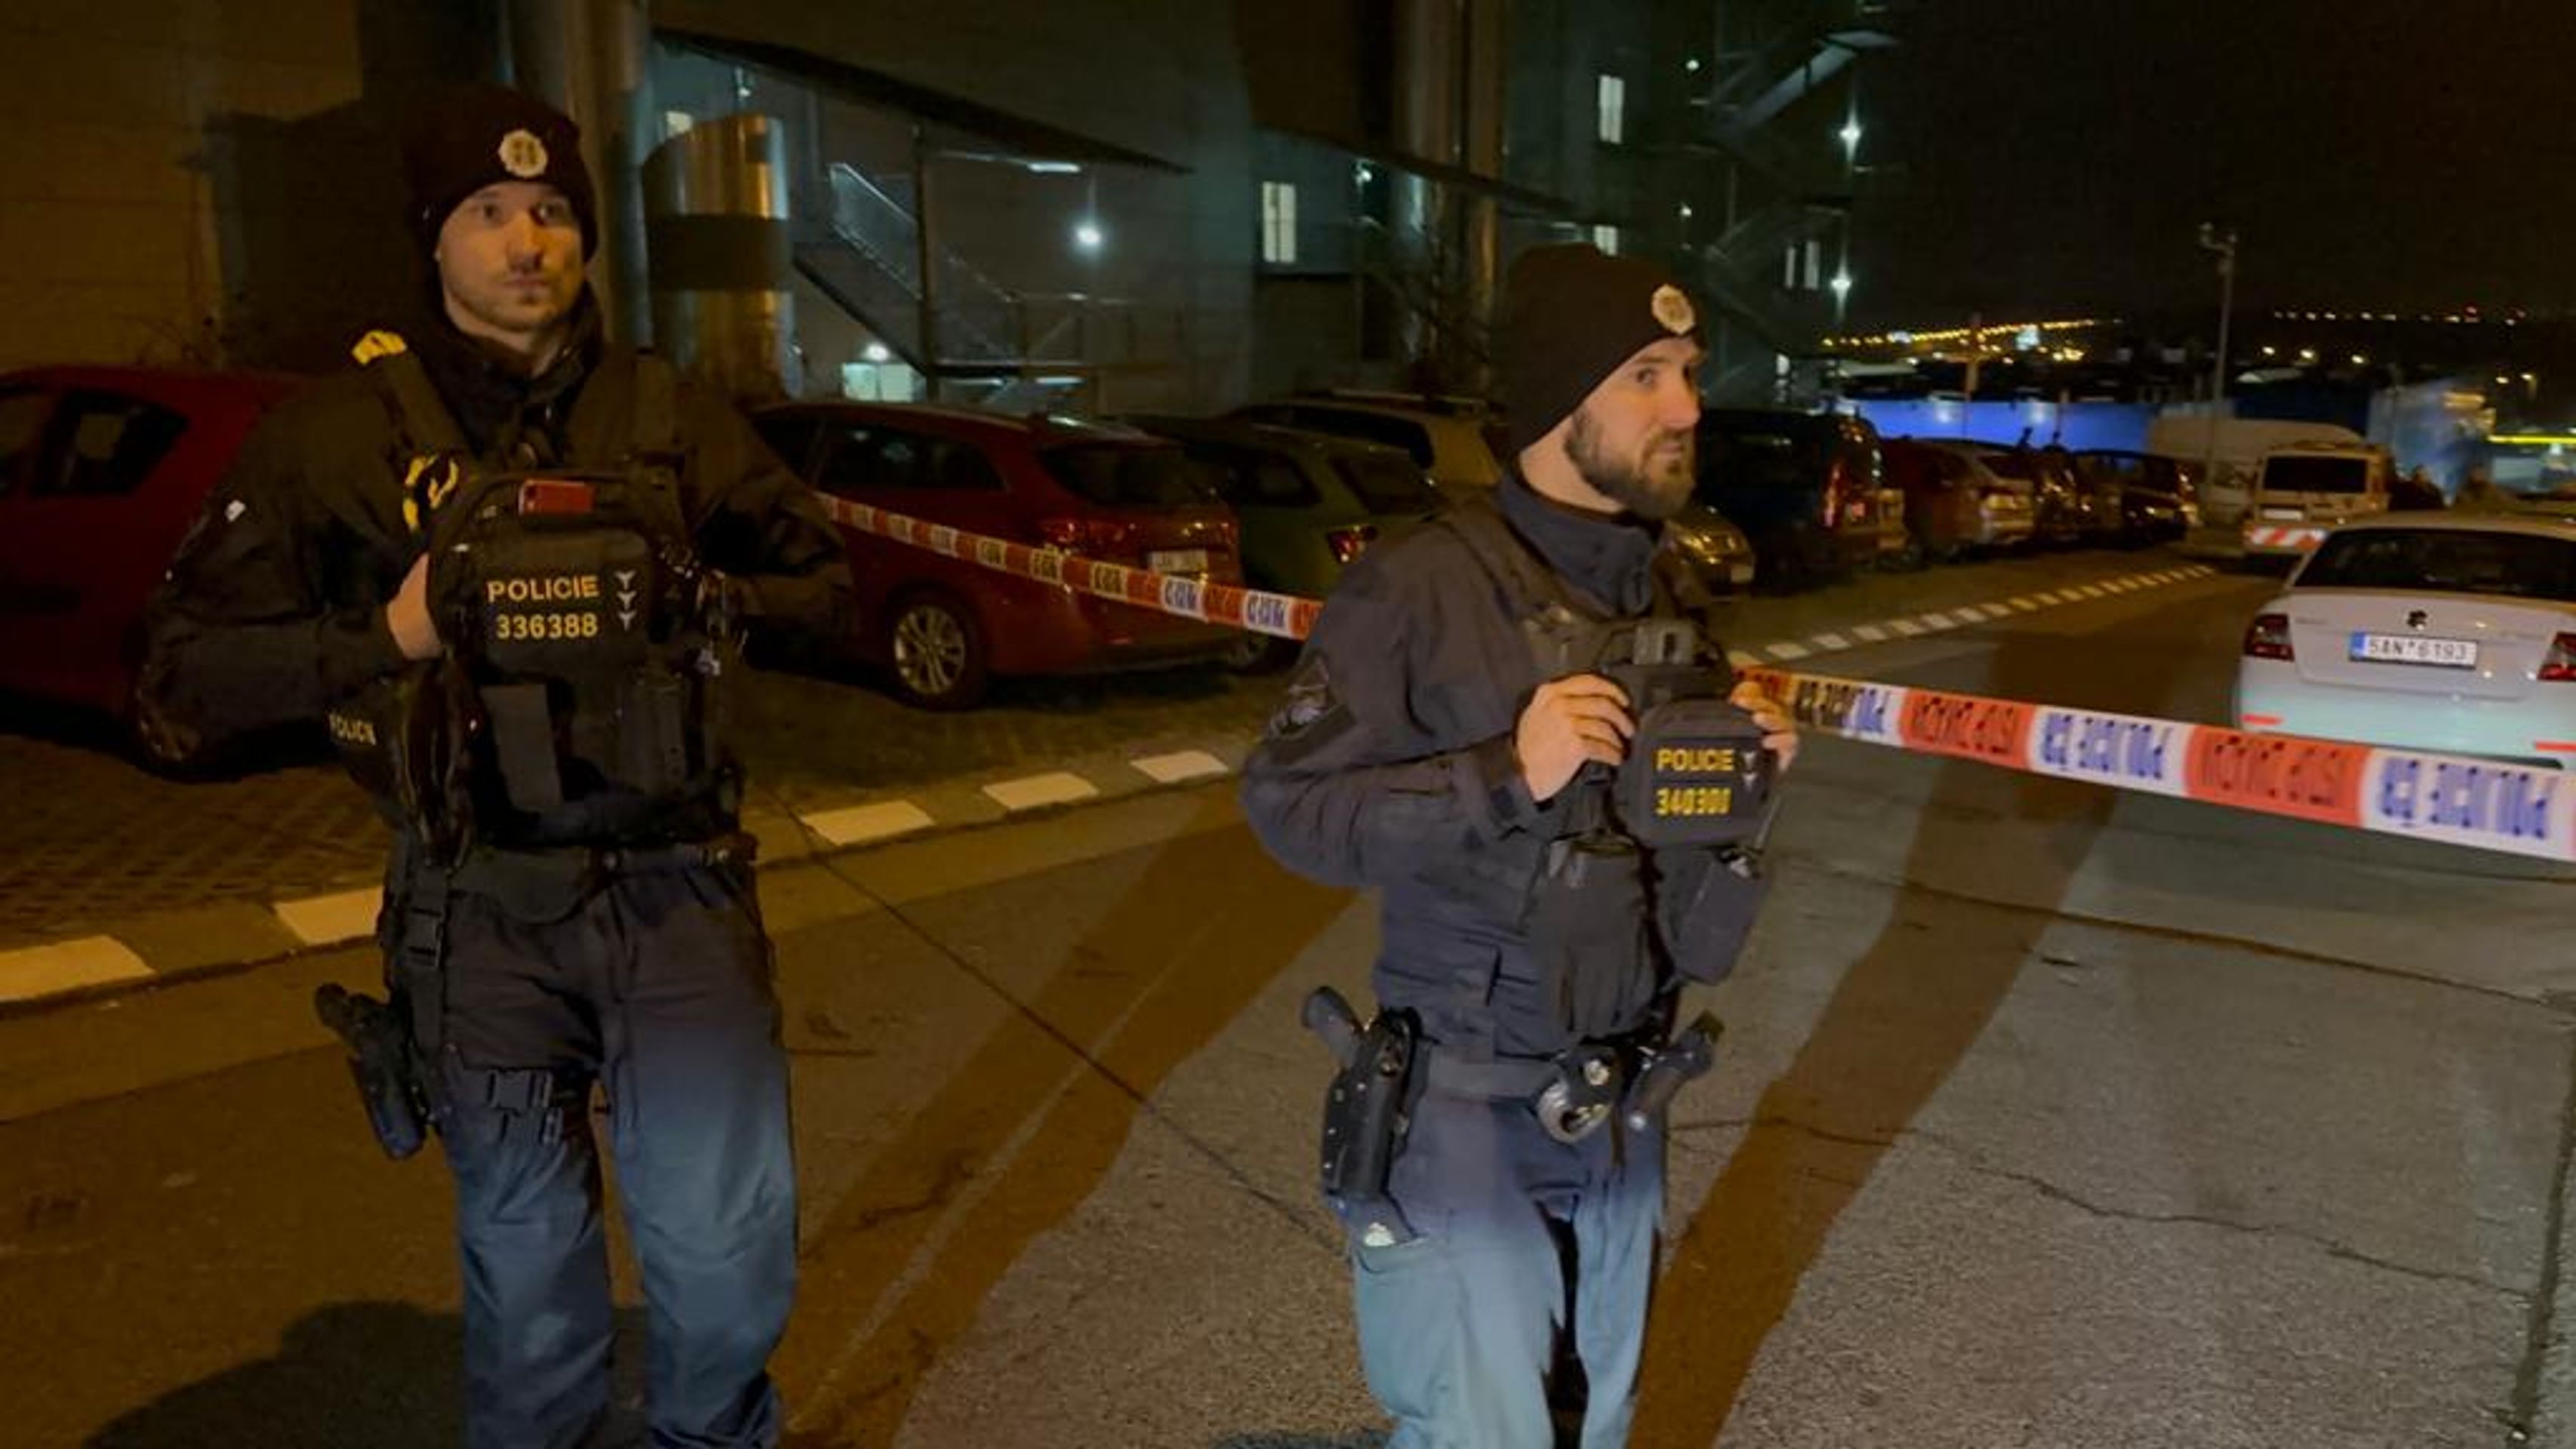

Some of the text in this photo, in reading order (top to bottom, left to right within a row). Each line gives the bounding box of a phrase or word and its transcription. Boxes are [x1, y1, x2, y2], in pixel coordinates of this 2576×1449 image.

[488, 576, 599, 602] POLICIE
[496, 613, 598, 639] 336388
[1657, 748, 1735, 771] POLICIE
